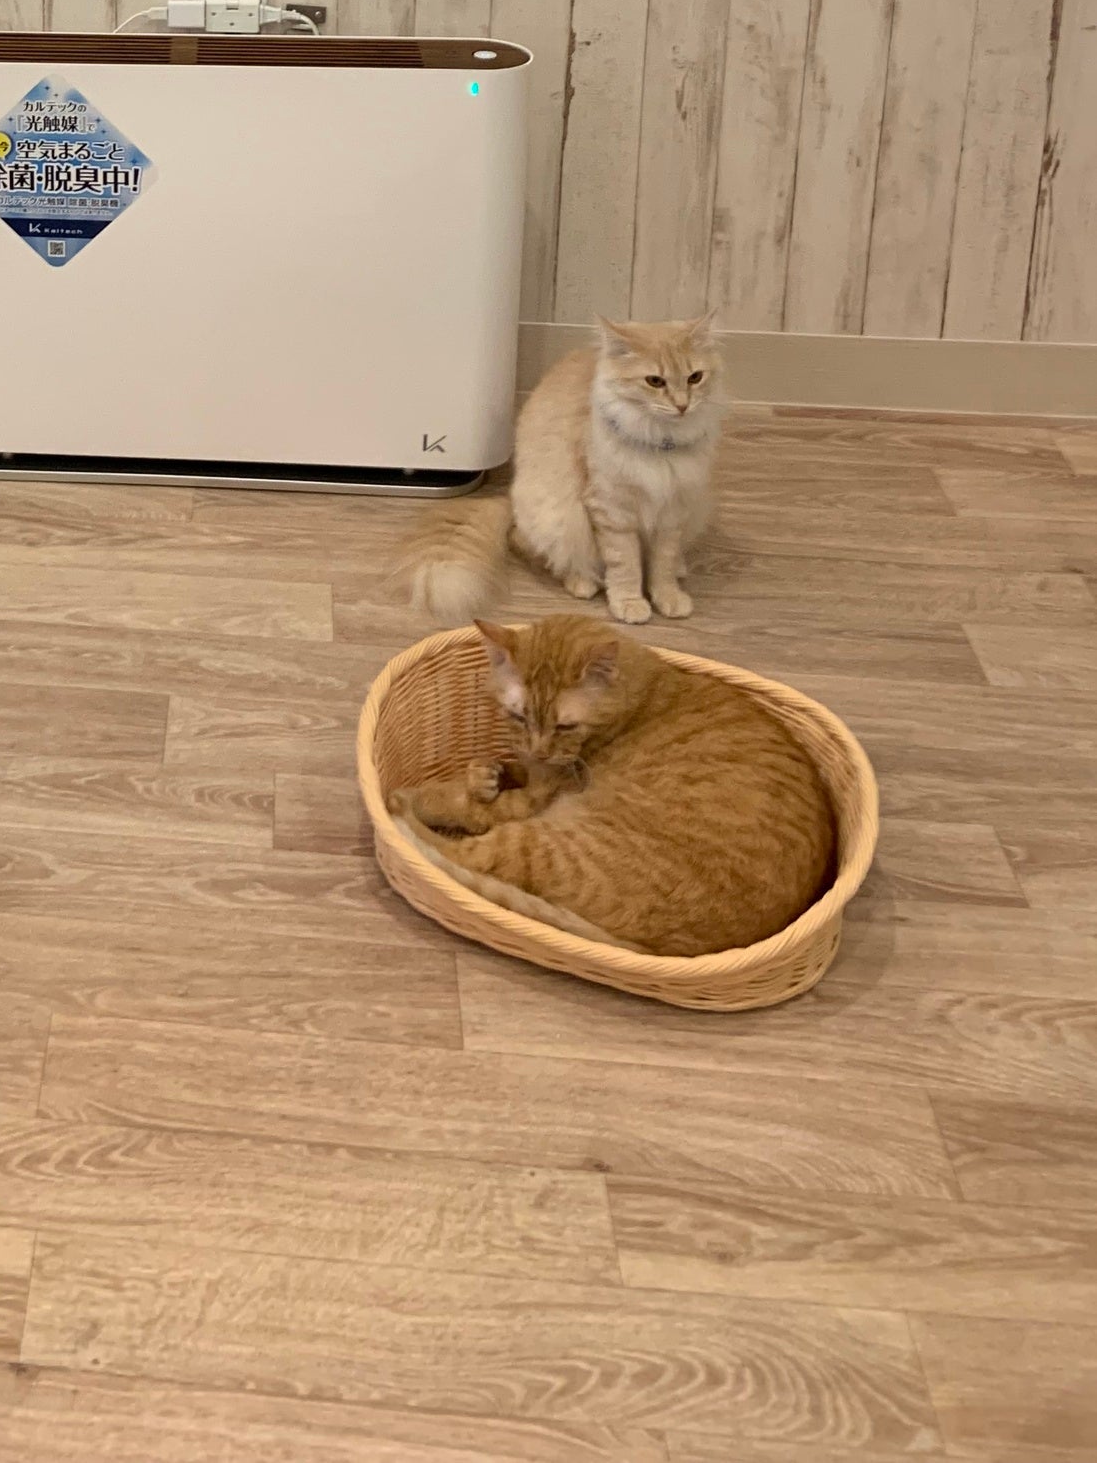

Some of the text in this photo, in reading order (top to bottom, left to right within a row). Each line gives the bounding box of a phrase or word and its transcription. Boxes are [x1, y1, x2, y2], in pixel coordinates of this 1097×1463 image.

[23, 101, 87, 113] カルテックの
[16, 140, 125, 161] 空気まるごと
